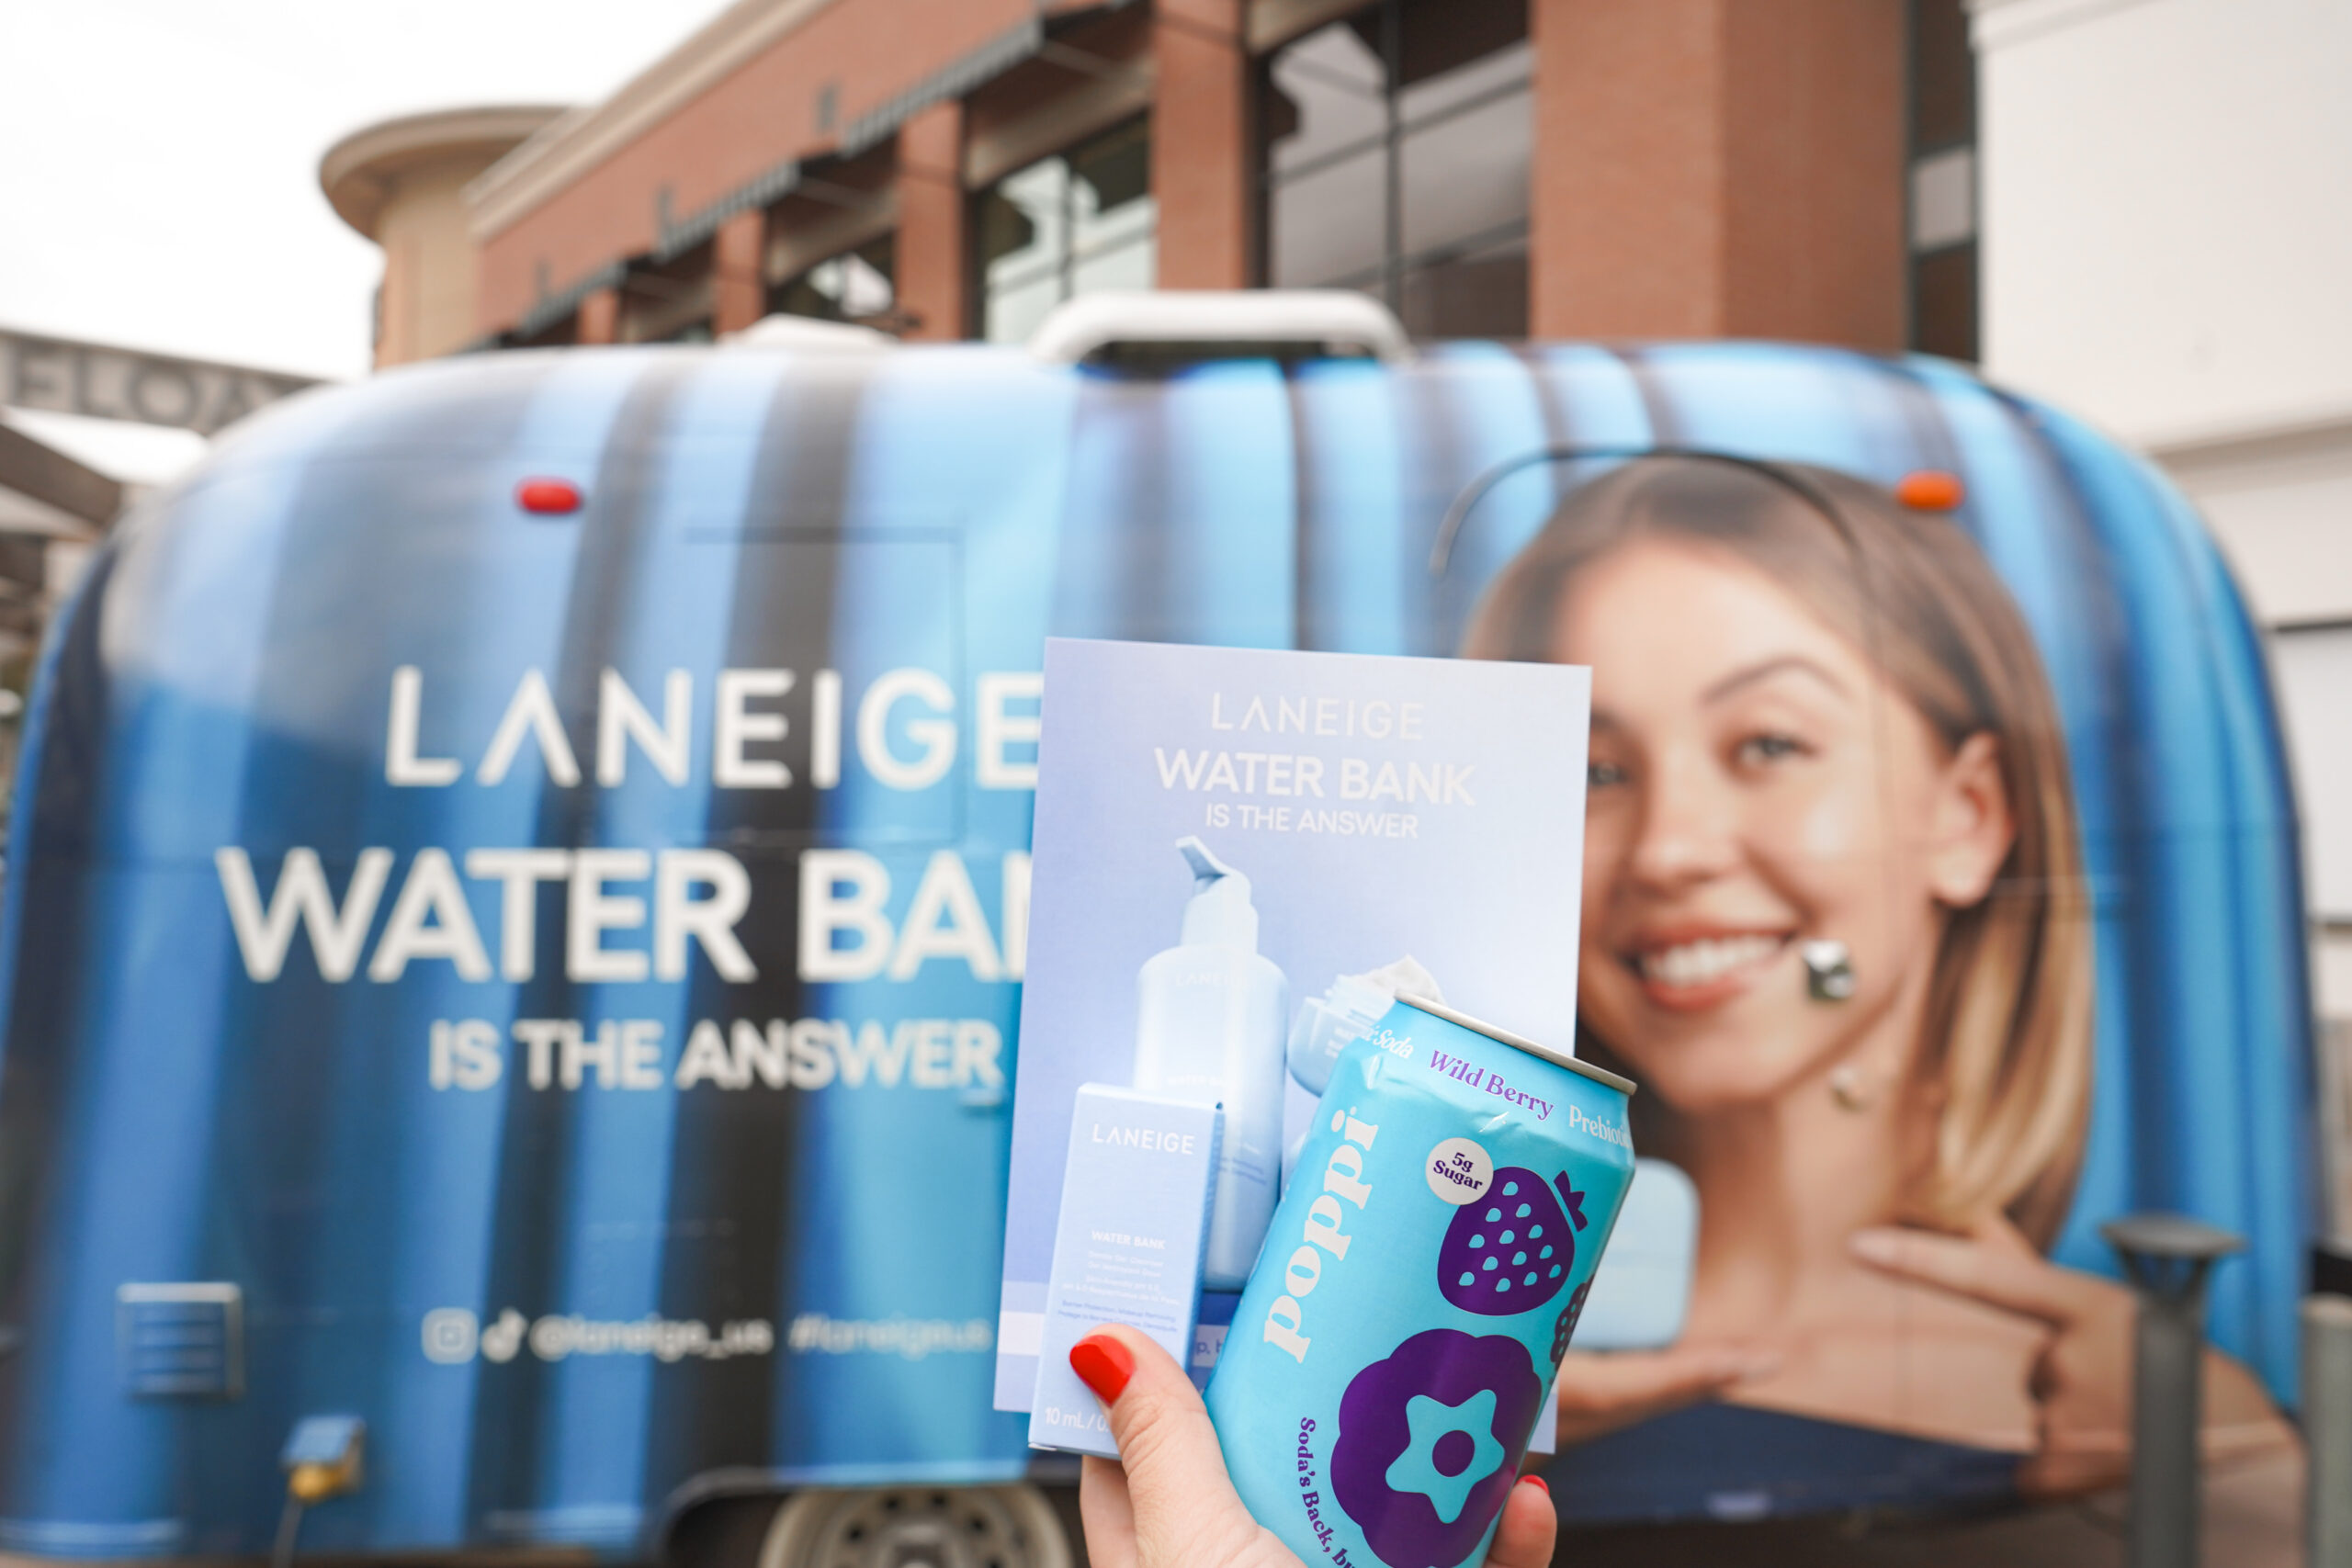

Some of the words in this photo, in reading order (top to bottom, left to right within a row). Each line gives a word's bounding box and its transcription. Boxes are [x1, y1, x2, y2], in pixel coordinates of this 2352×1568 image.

[386, 665, 1045, 791] LANEIGE
[1211, 691, 1426, 740] LANEIGE
[1154, 747, 1326, 798] WATER
[1339, 758, 1477, 807] BANK
[1205, 803, 1230, 828] IS
[1238, 805, 1291, 832] THE
[1297, 809, 1419, 840] ANSWER
[215, 847, 759, 983] WATER
[429, 1018, 503, 1092] IS
[512, 1018, 664, 1092] THE
[674, 1018, 1007, 1092] ANSWER
[1373, 1029, 1414, 1058] Soda
[1430, 1050, 1485, 1088] Wild
[1485, 1073, 1554, 1121] Berry
[1092, 1122, 1196, 1156] LANEIGE
[1452, 1152, 1474, 1173] 5g
[1433, 1159, 1483, 1190] Sugar
[1091, 1230, 1131, 1246] WATER
[1134, 1236, 1167, 1250] BANK
[1263, 1108, 1379, 1364] poppi
[1045, 1406, 1060, 1425] 10
[1062, 1410, 1084, 1429] mL
[1297, 1416, 1317, 1488] Soda's
[1302, 1491, 1334, 1553] Back,
